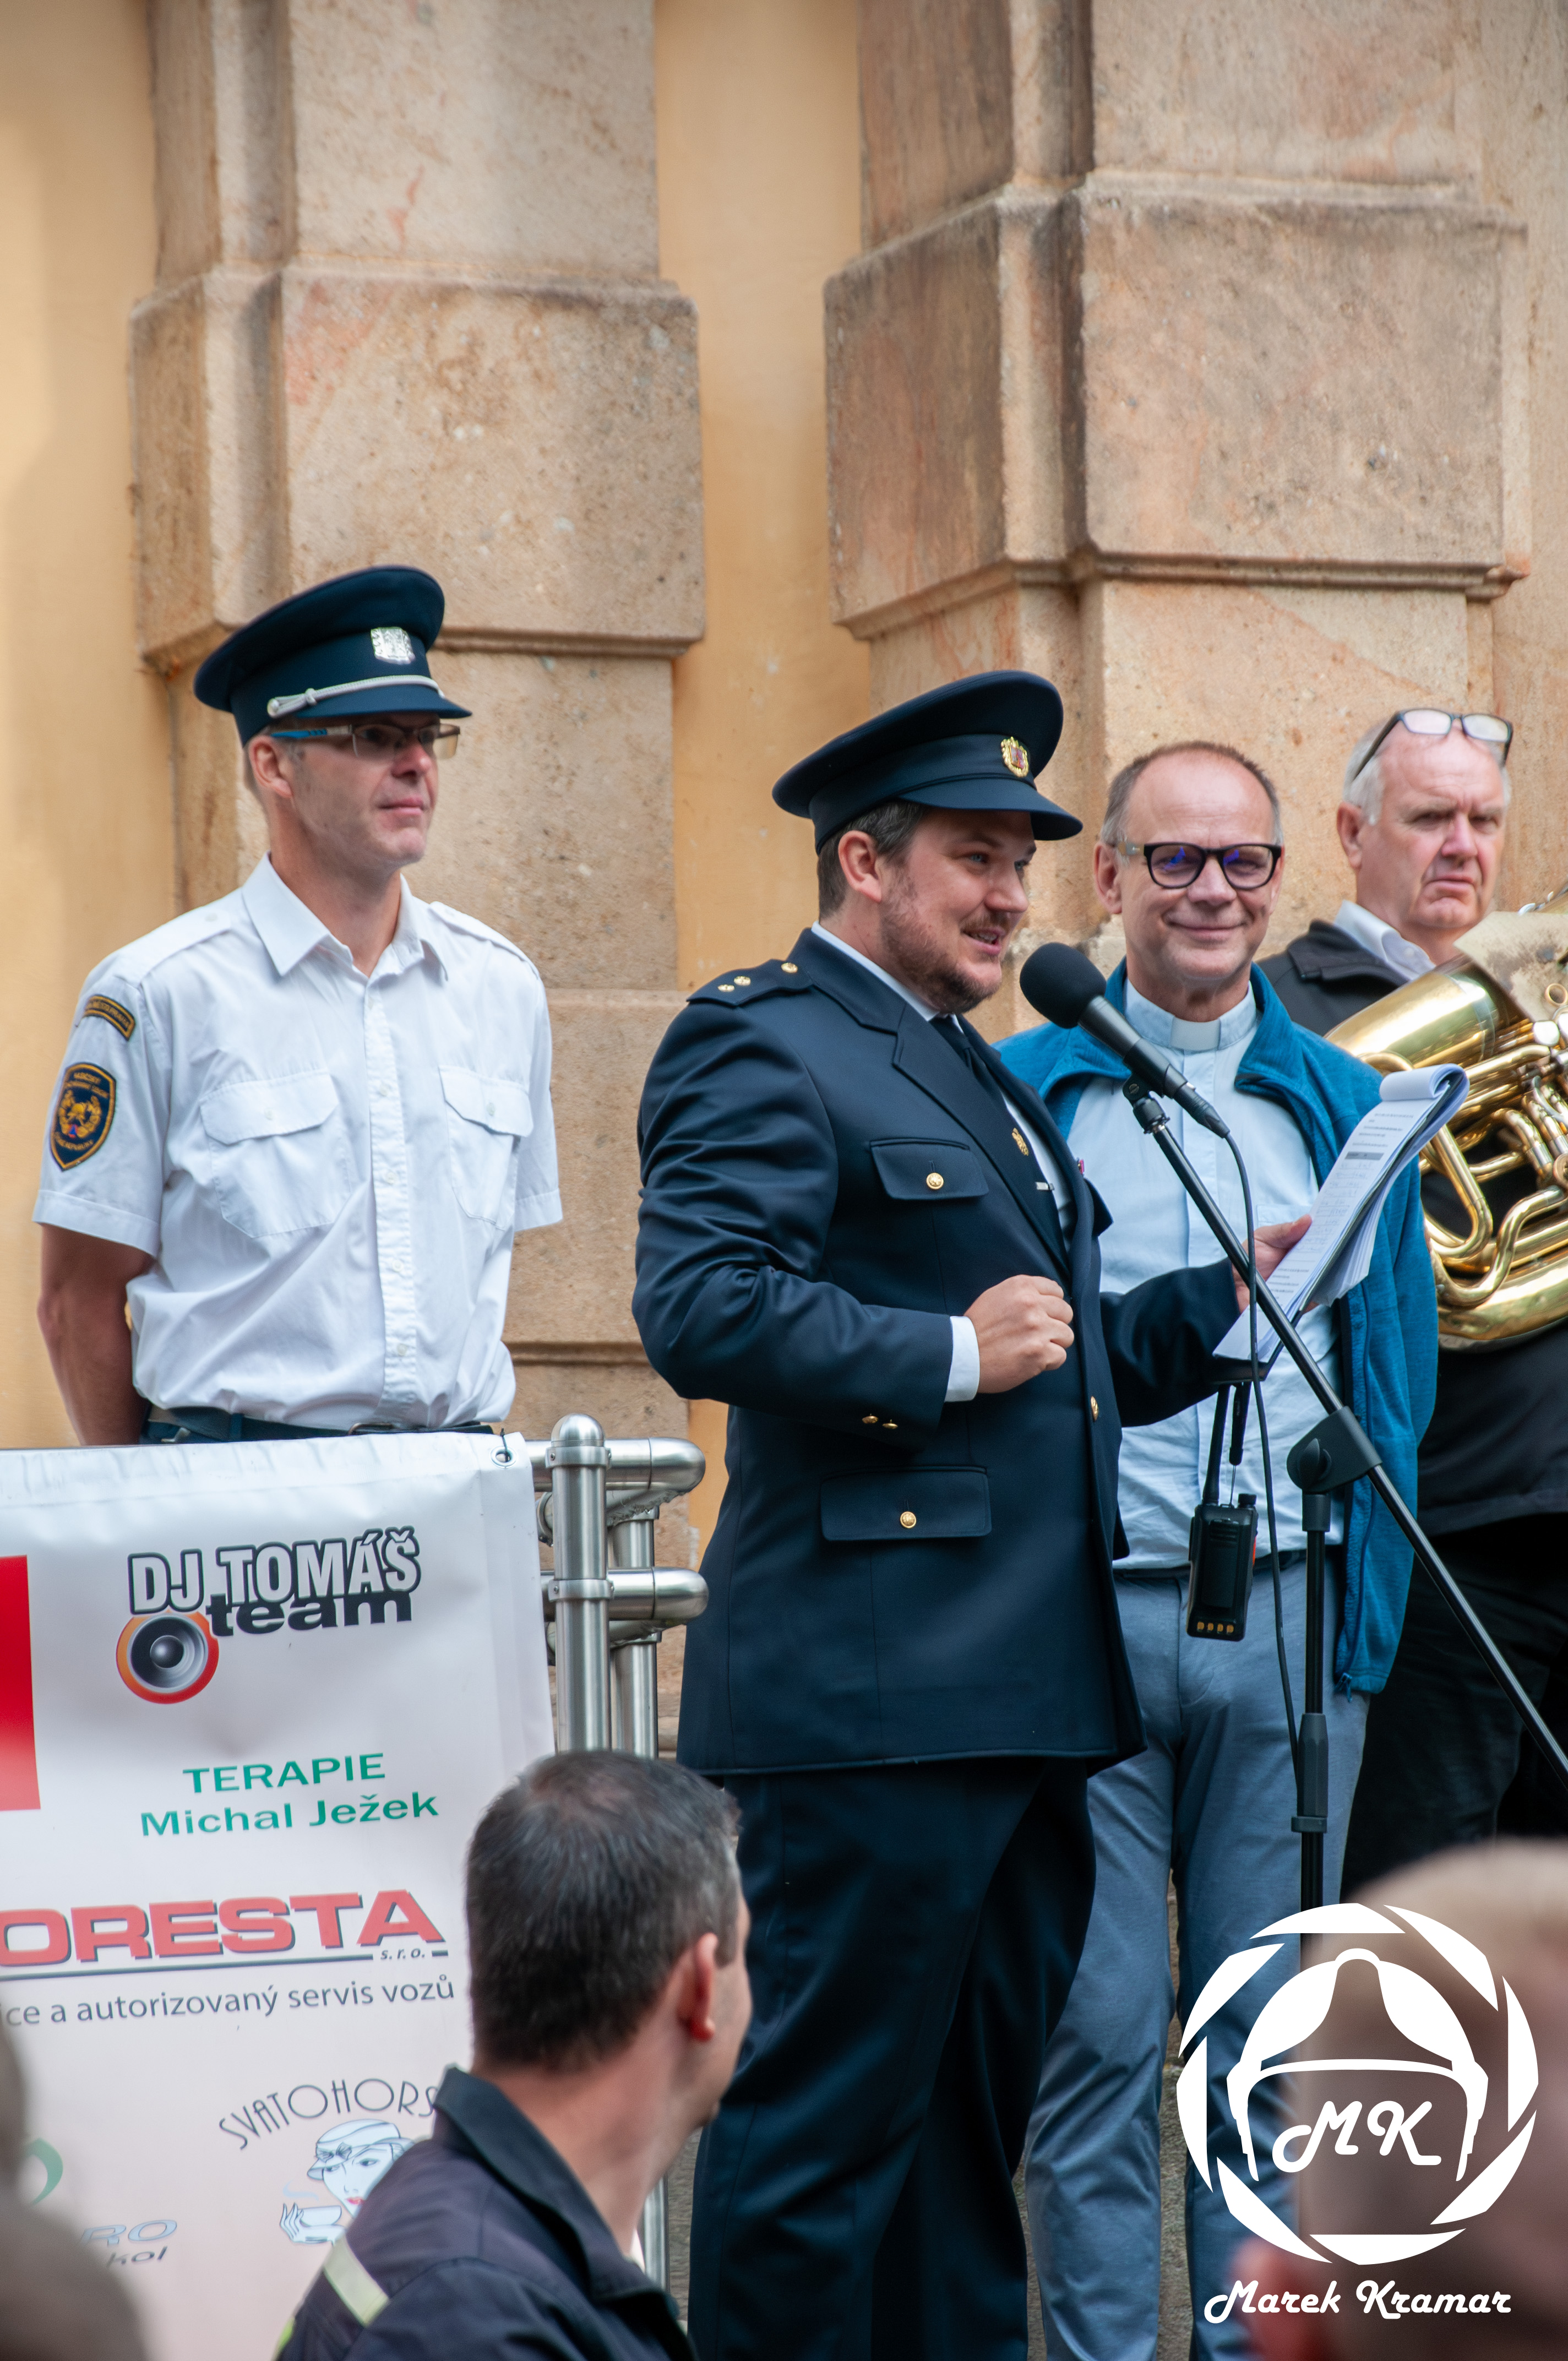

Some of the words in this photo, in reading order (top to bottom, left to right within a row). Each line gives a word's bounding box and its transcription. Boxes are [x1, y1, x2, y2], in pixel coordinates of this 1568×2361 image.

[127, 1548, 204, 1614] DJ
[215, 1526, 421, 1607] TOMÁŠ
[205, 1592, 412, 1636] team
[182, 1753, 385, 1793] TERAPIE
[141, 1803, 293, 1836] Michal
[309, 1791, 439, 1827] Ježek
[0, 1889, 445, 1967] ORESTA
[51, 2004, 67, 2023] a
[77, 1984, 278, 2021] autorizovaný
[288, 1981, 374, 2009] servis
[382, 1974, 455, 2003] vozů
